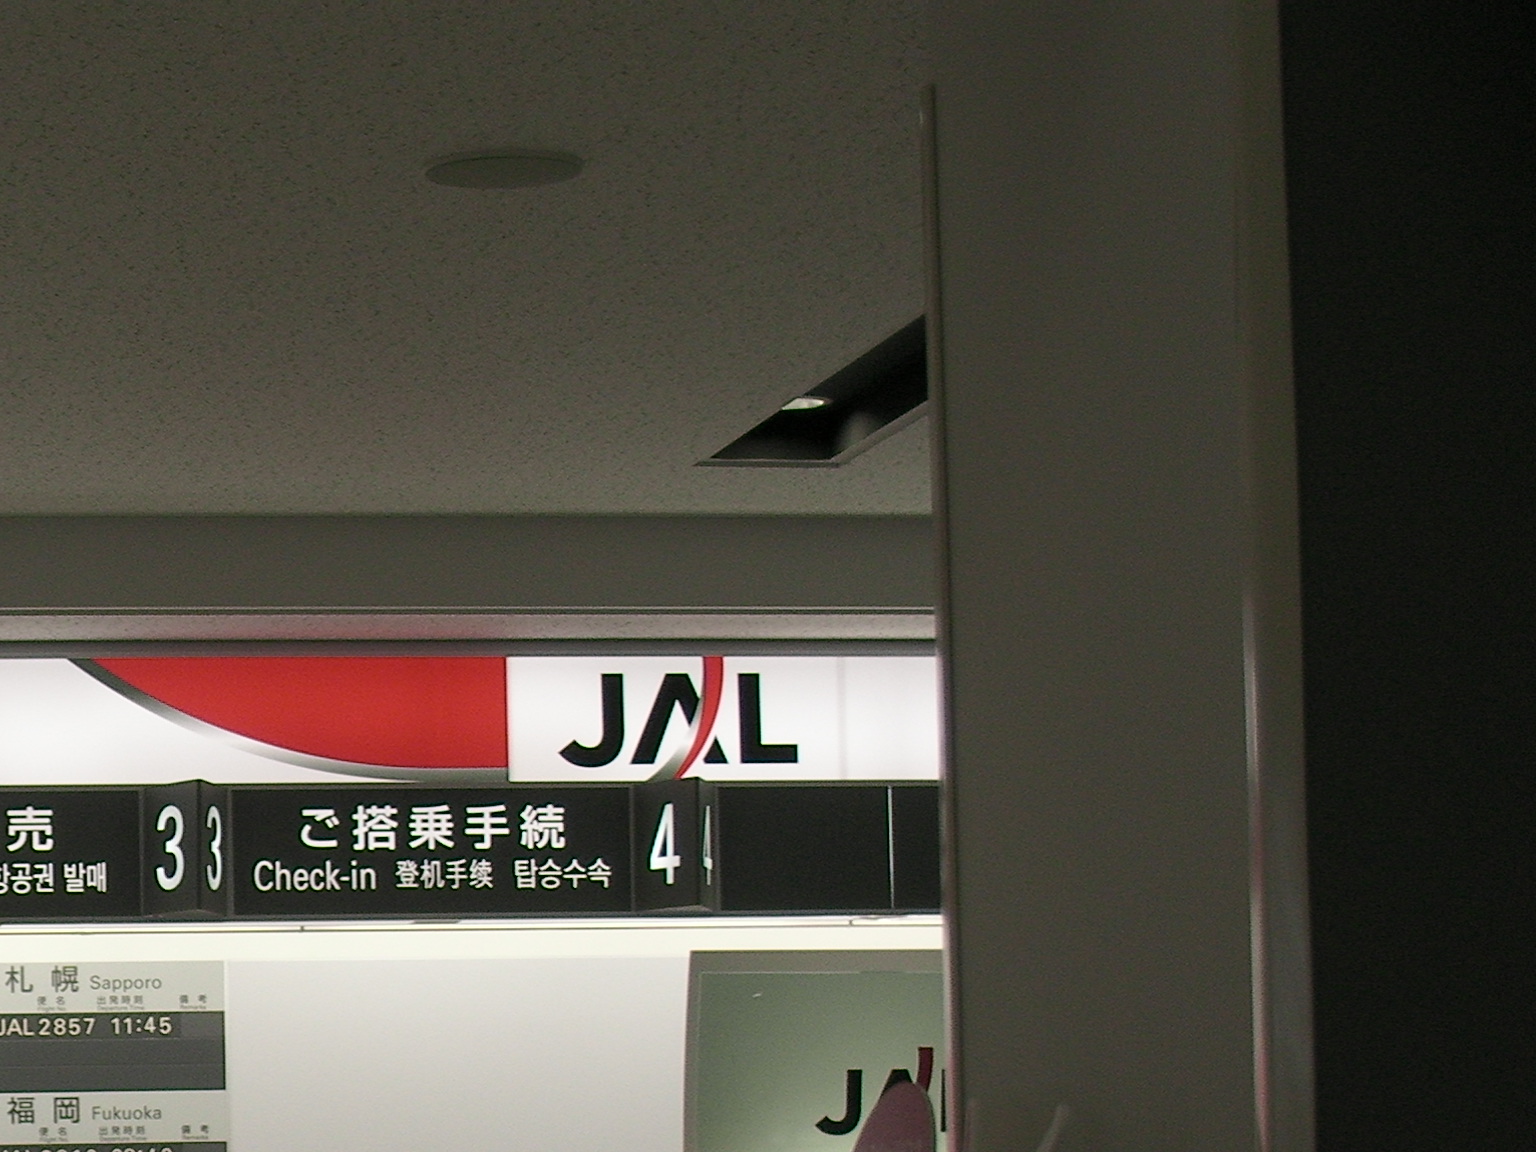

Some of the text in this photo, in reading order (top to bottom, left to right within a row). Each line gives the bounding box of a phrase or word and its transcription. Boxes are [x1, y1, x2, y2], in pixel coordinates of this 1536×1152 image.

[559, 671, 799, 767] JAL
[300, 803, 566, 851] ご搭乗手続
[649, 802, 681, 885] 4
[155, 804, 185, 892] 3
[206, 804, 223, 892] 3
[701, 804, 715, 886] 4
[63, 860, 107, 894] 발매
[253, 858, 376, 893] Check-in
[395, 857, 494, 890] 登机手续
[514, 857, 613, 890] 탑승수속
[89, 974, 163, 993] Sapporo
[111, 1016, 173, 1035] 11:45
[7, 1096, 80, 1125] 福岡
[91, 1105, 162, 1121] Fukuoka
